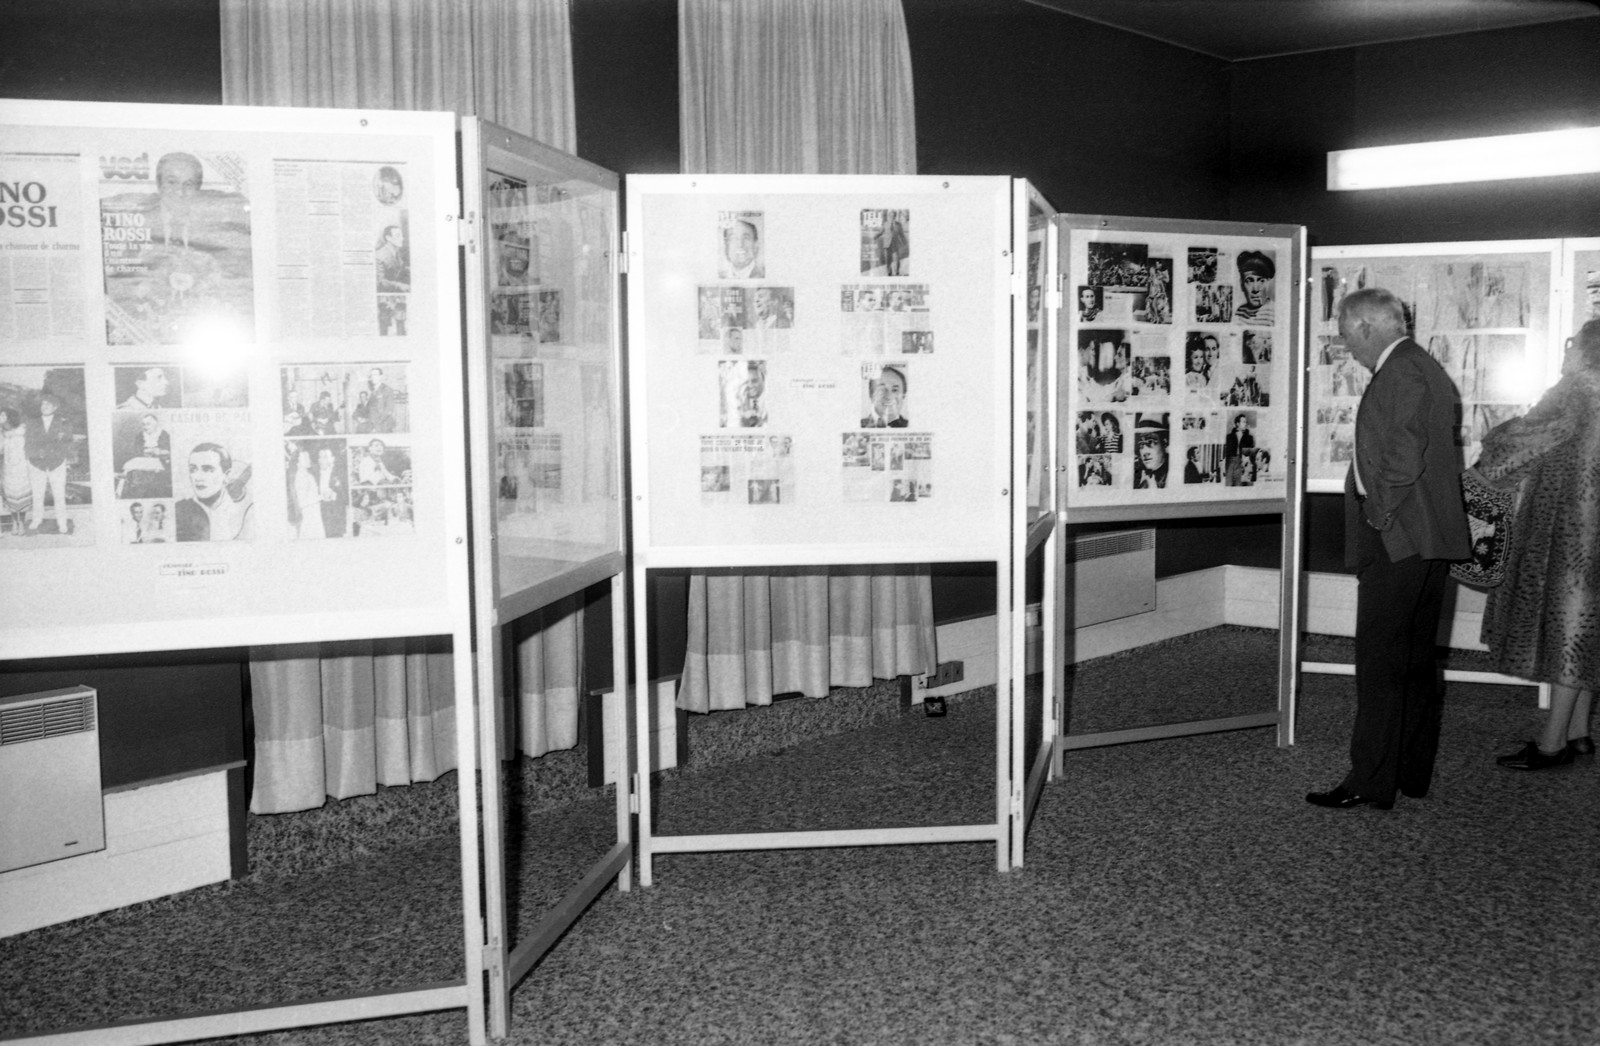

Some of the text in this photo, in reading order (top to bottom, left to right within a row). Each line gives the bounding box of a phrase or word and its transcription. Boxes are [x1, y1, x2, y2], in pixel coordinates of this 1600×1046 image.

[0, 205, 58, 228] SSI
[102, 212, 145, 227] TINO
[103, 227, 152, 242] ROSSI
[5, 241, 39, 250] chanteur
[40, 241, 49, 250] de
[52, 241, 80, 251] charme
